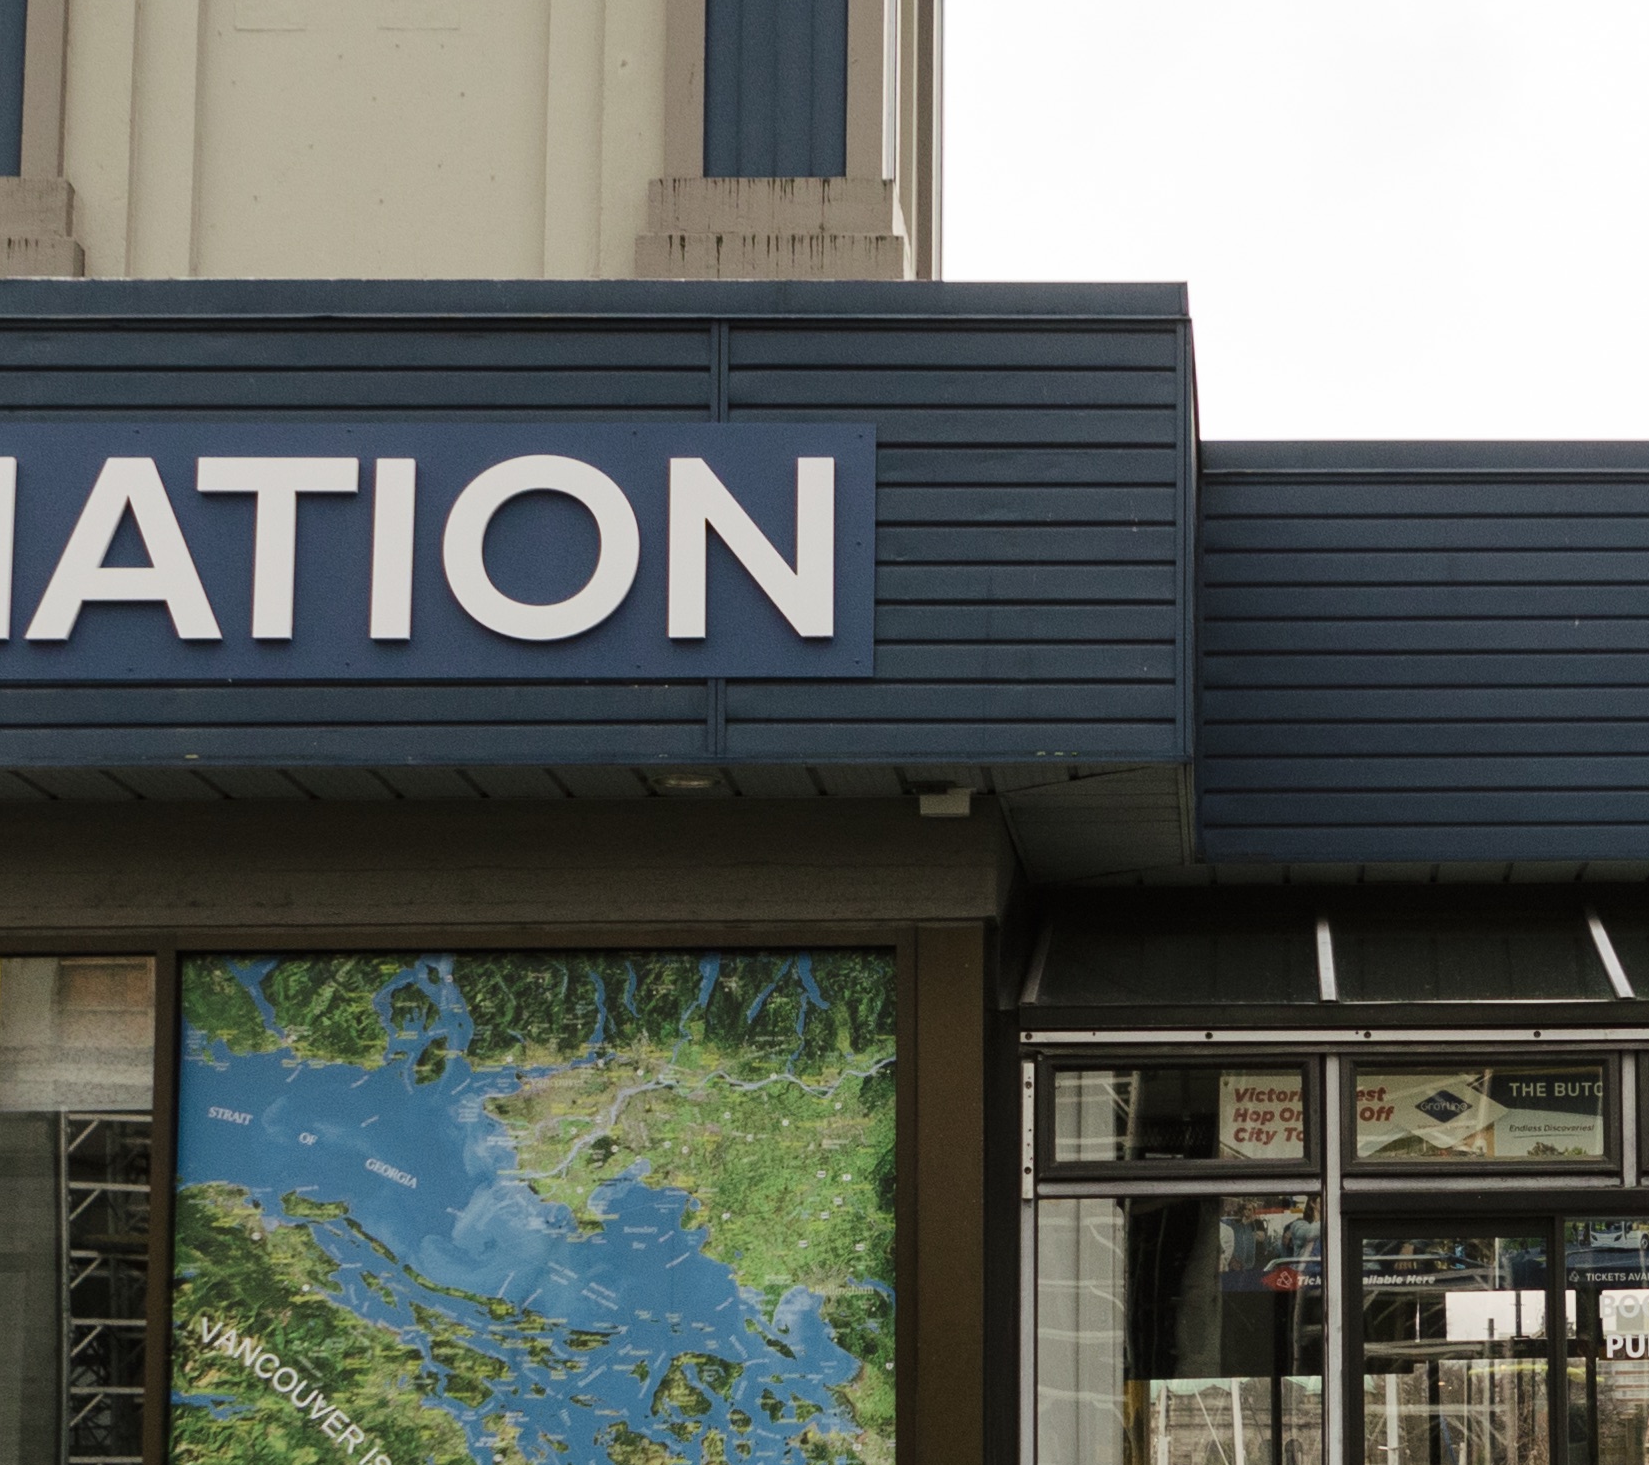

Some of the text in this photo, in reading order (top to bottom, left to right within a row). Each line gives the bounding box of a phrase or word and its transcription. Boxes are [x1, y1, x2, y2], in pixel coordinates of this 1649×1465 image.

[1509, 1082, 1546, 1097] THE
[1233, 1108, 1276, 1125] Hop
[1360, 1106, 1394, 1122] Off
[1233, 1127, 1276, 1145] City
[1509, 1123, 1542, 1133] Endless
[208, 1106, 418, 1189] STRAIT OF GEORGIA
[1406, 1275, 1435, 1285] Here
[1585, 1272, 1626, 1282] TICKETS
[200, 1316, 365, 1455] VANCOUVER
